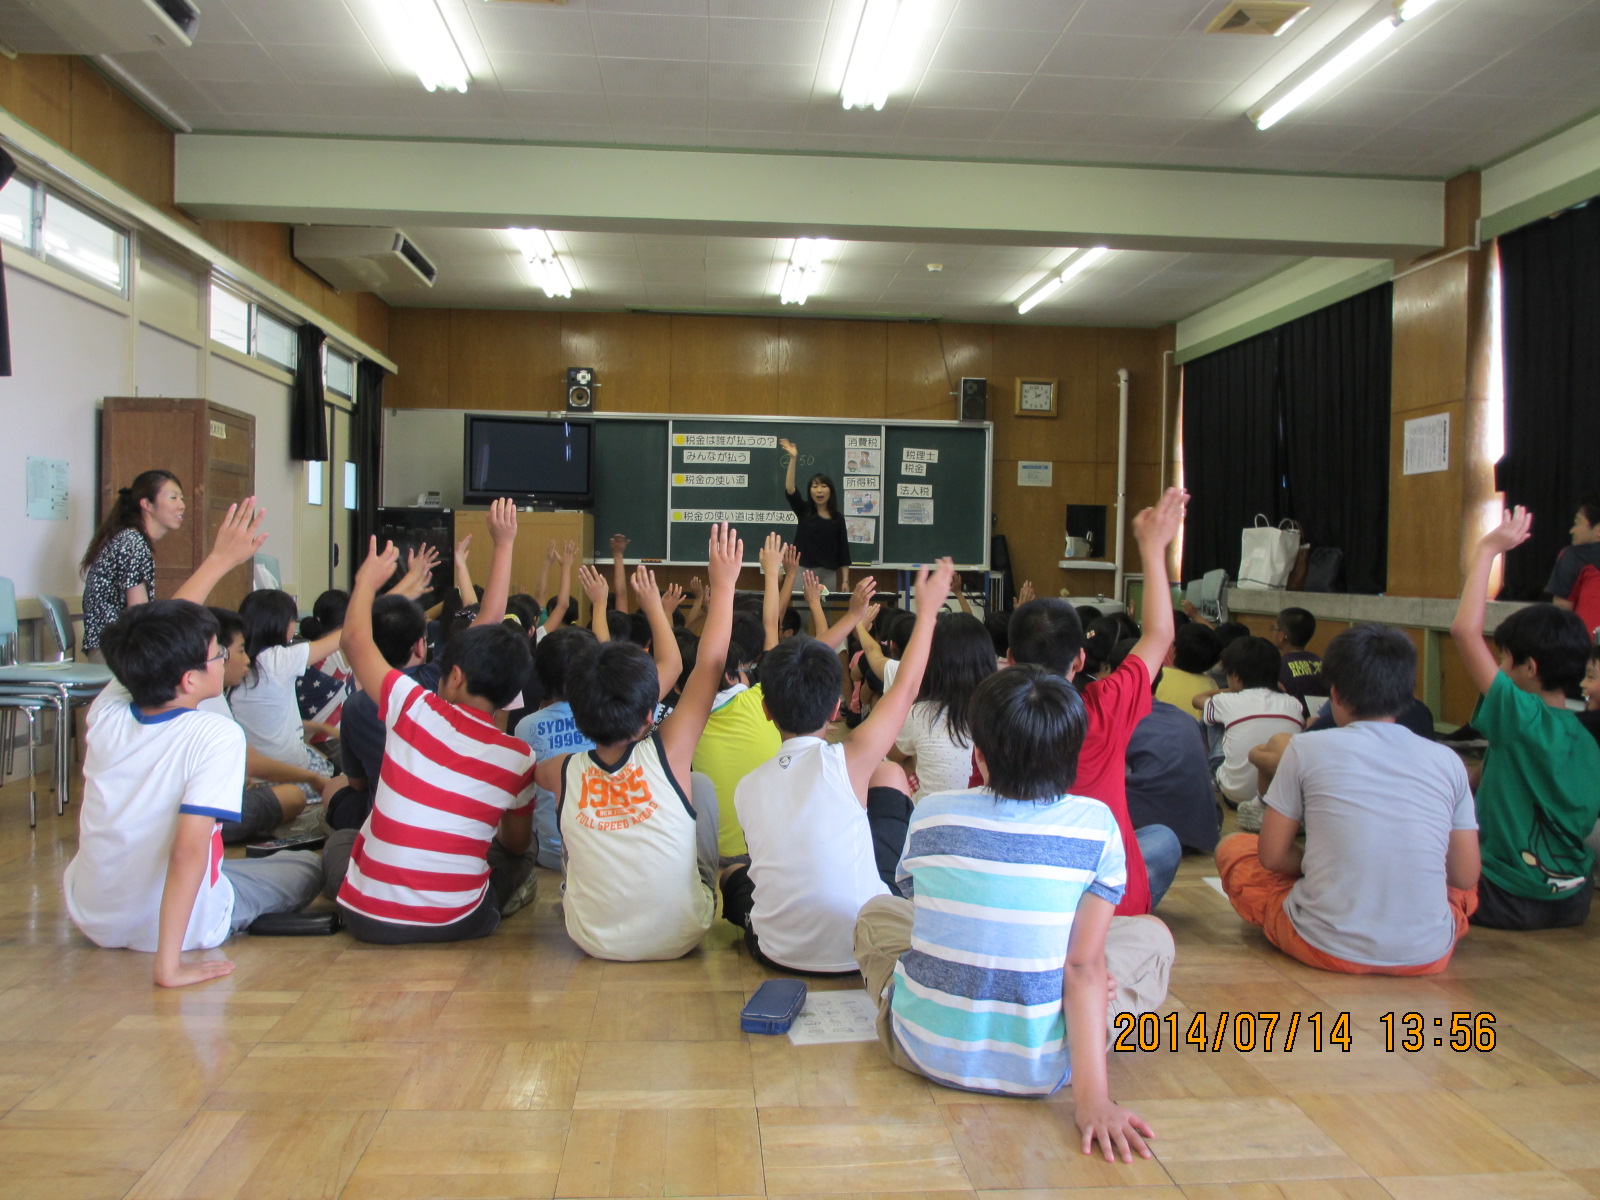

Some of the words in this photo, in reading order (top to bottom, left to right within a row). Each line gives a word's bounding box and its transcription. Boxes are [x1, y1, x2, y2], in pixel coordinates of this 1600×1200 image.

[848, 437, 878, 448] 消費税
[686, 451, 747, 462] みんなが払う
[906, 450, 935, 461] 税理士
[905, 463, 924, 474] 税金
[685, 474, 746, 485] 税金の使い道
[846, 478, 876, 487] 所得税
[900, 486, 930, 496] 法人税
[683, 511, 798, 521] 税金の使い道は誰が決め
[548, 731, 583, 750] 1996
[578, 765, 652, 809] 1985
[576, 812, 595, 829] FULL
[597, 819, 630, 831] SPEED
